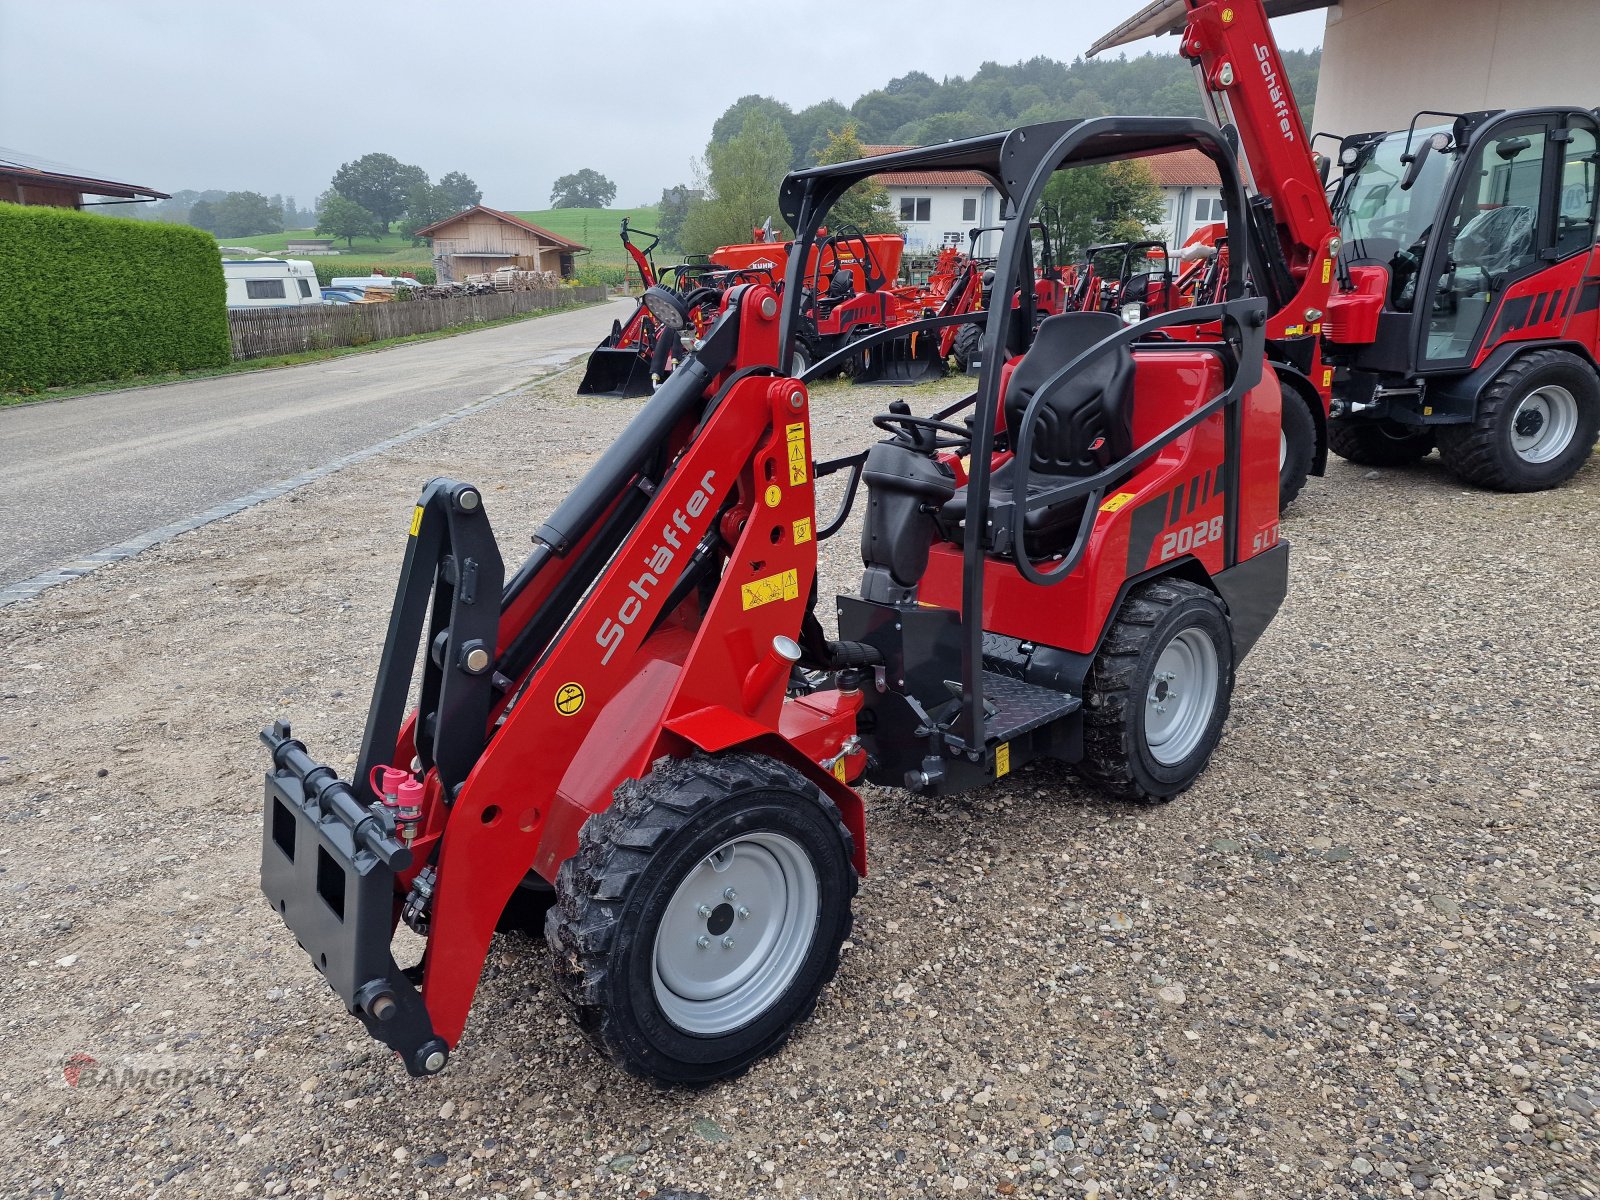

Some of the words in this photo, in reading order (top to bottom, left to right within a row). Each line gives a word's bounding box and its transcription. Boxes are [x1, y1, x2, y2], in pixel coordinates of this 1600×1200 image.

[1253, 43, 1294, 141] Schäffer
[752, 262, 773, 270] KUHN
[1160, 515, 1224, 560] 2028
[1251, 525, 1280, 554] SLT
[595, 469, 716, 666] Schäffer
